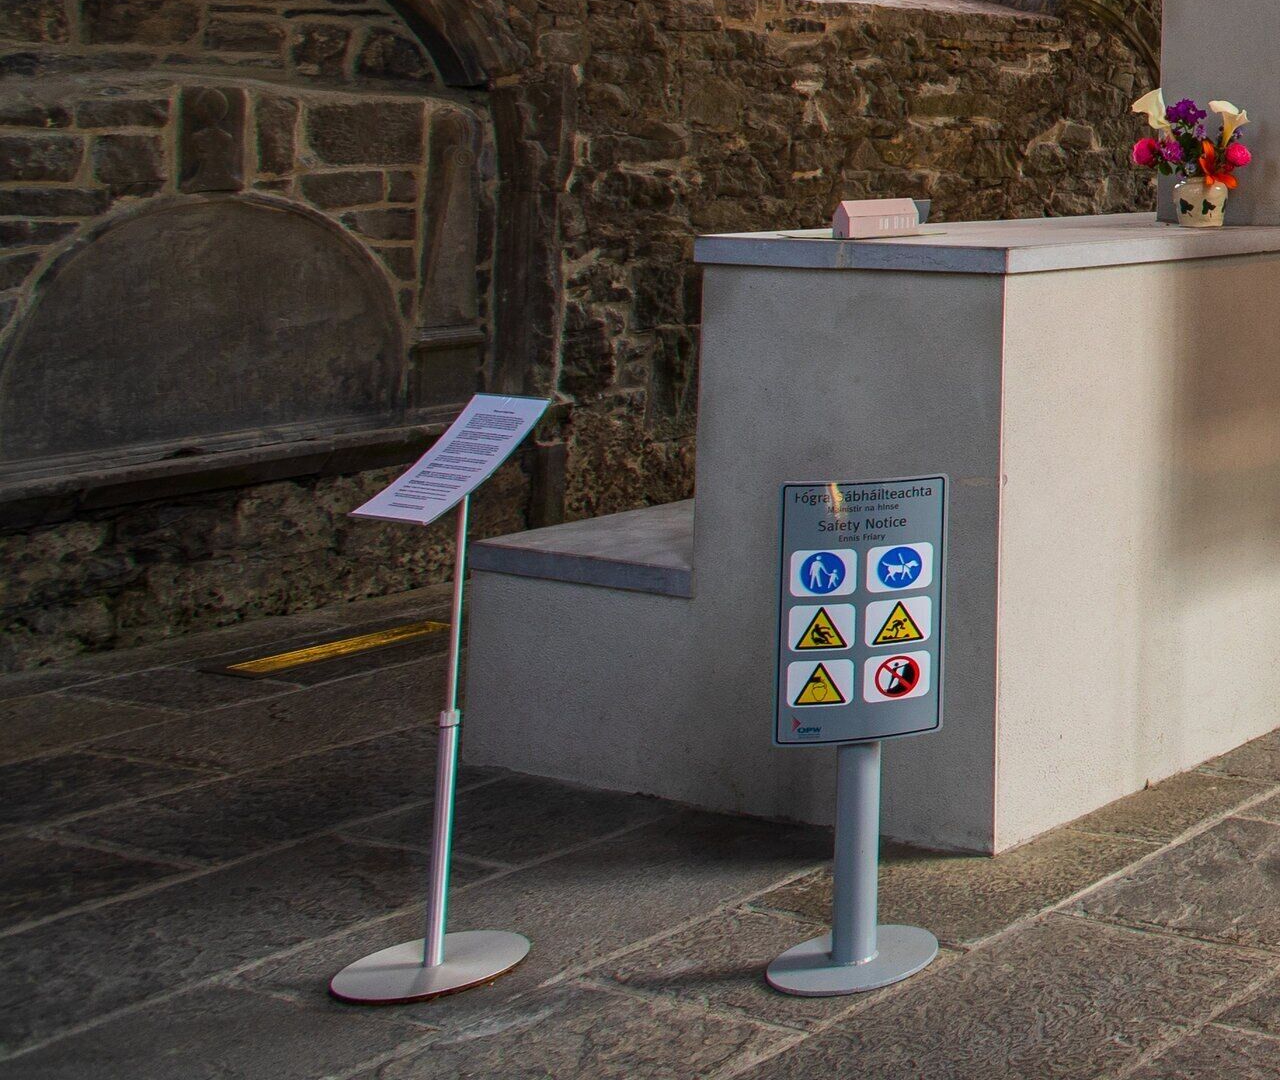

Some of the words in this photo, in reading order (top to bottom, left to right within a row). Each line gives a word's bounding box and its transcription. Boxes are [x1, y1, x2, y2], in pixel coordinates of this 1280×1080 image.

[818, 519, 860, 533] Safety
[865, 517, 907, 530] Notice
[838, 533, 860, 543] Ennis
[862, 532, 886, 542] Friary
[797, 726, 822, 734] OPW
